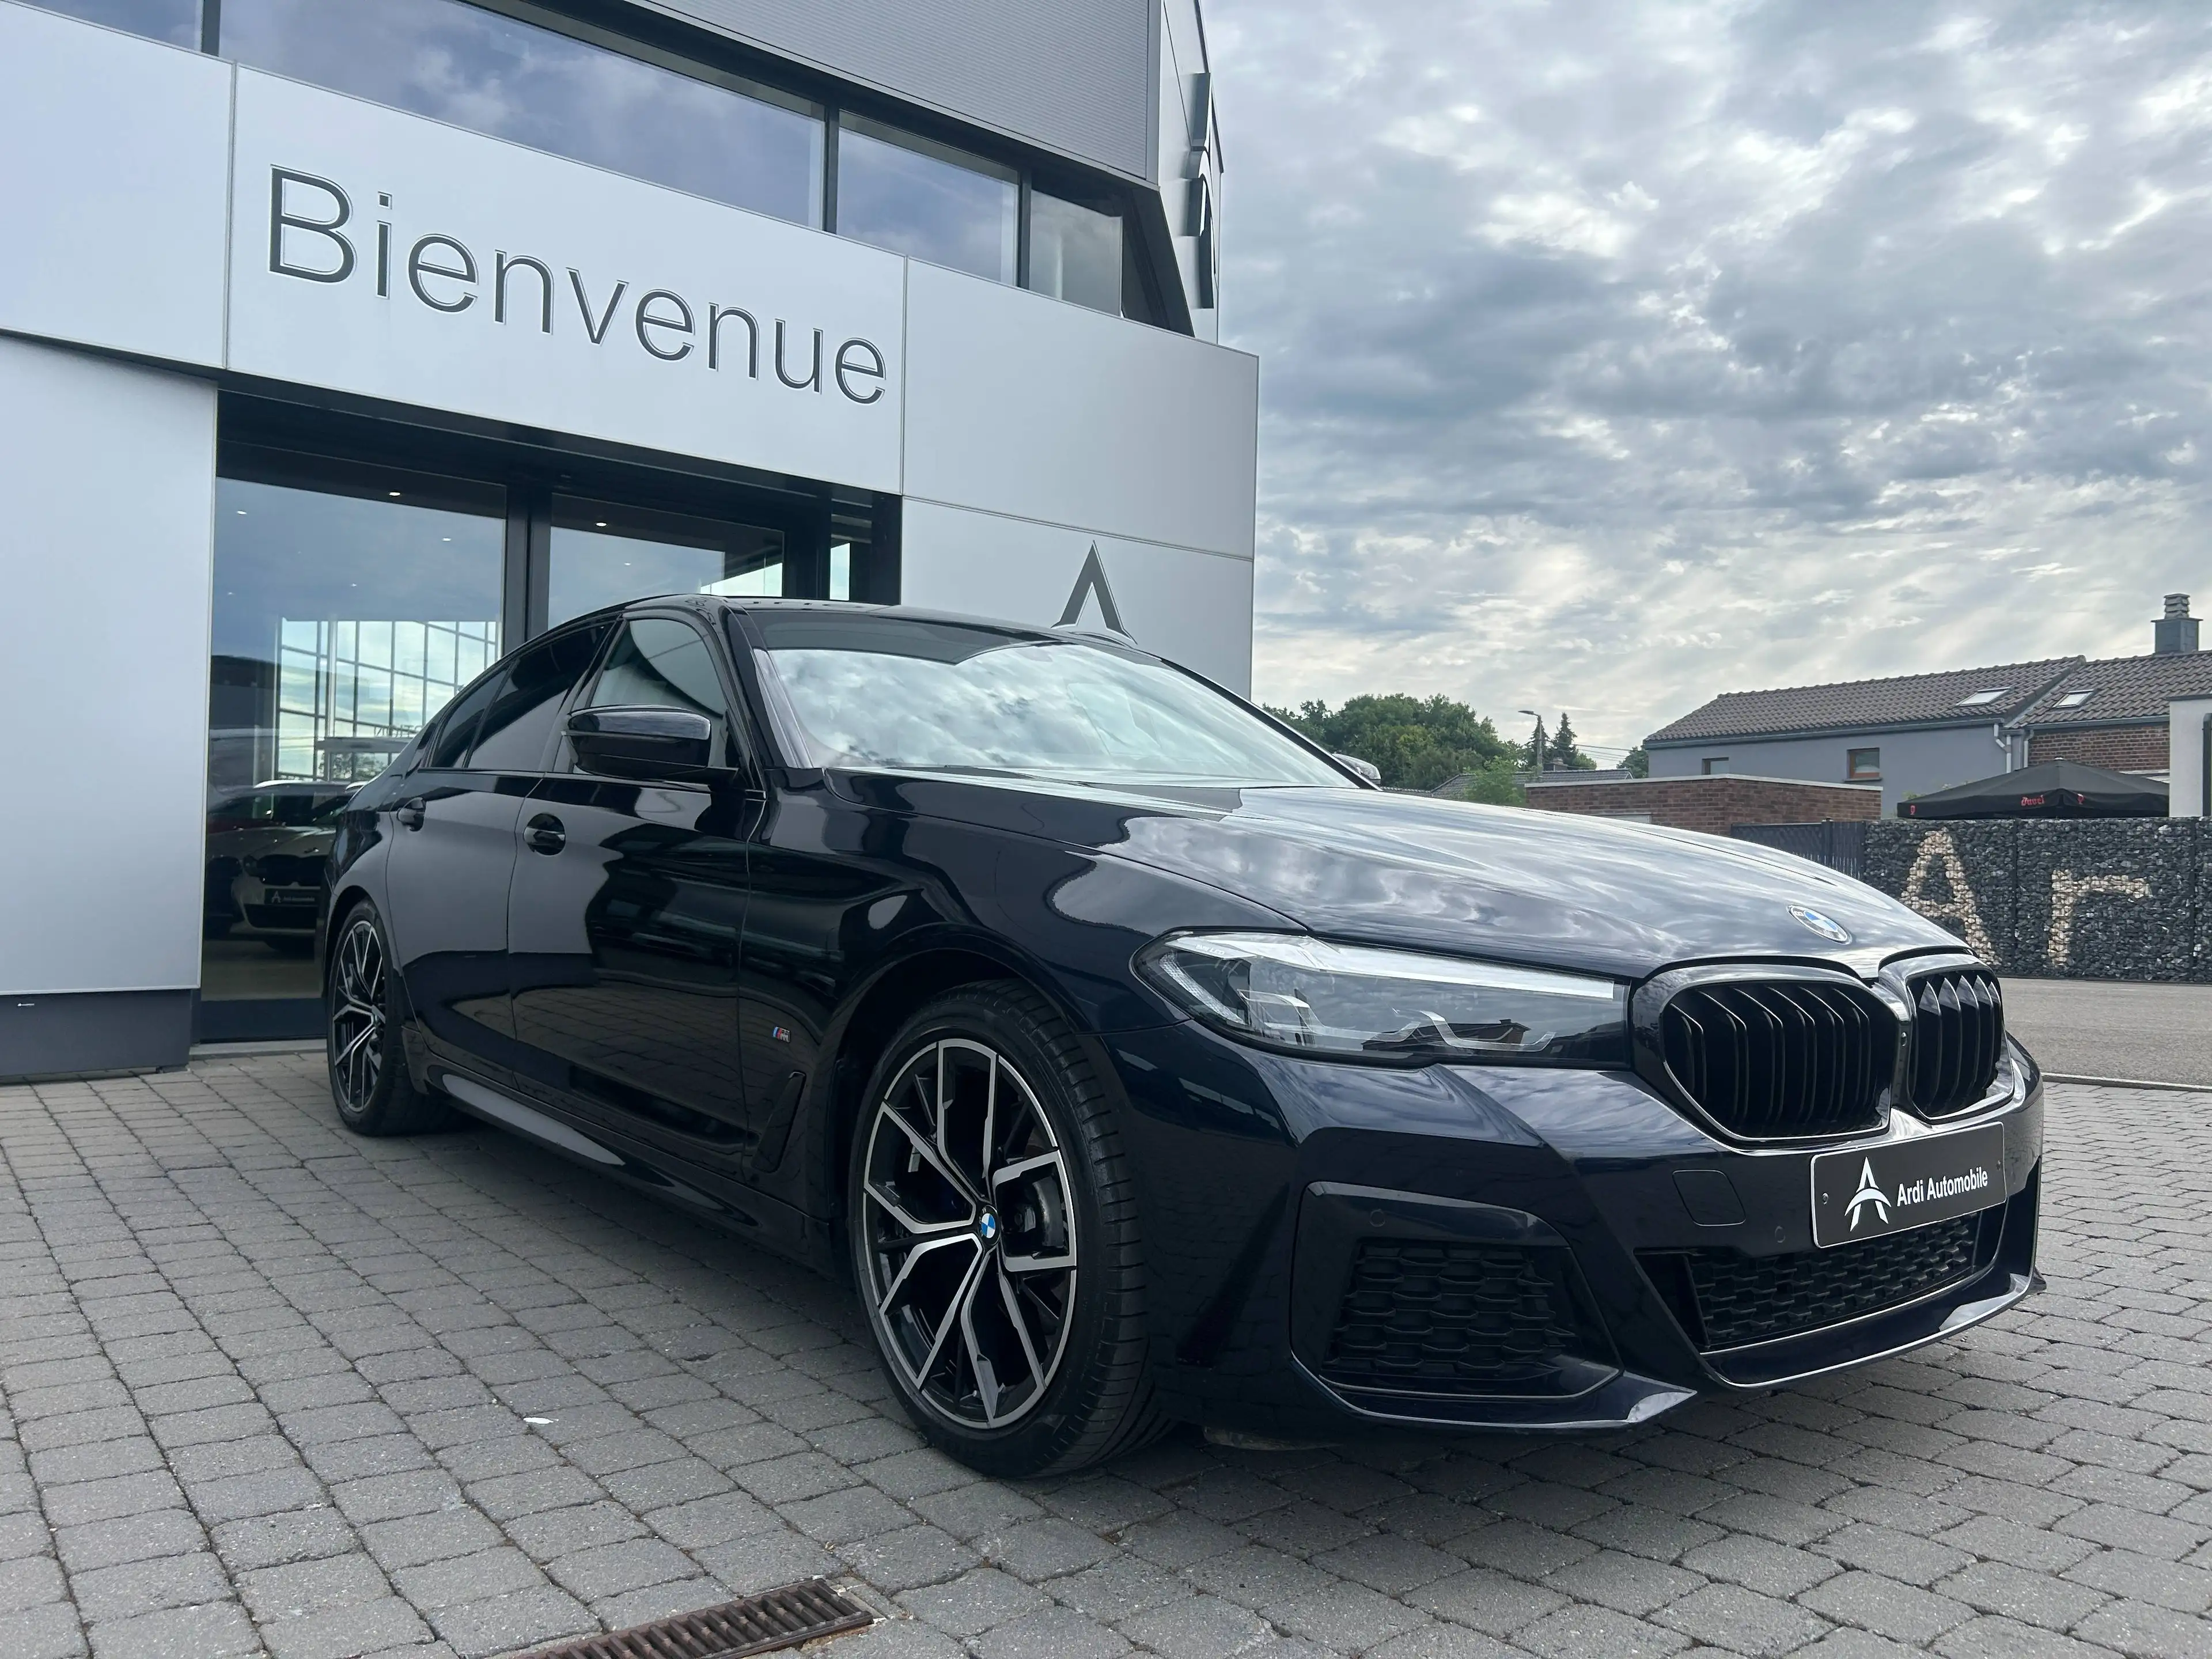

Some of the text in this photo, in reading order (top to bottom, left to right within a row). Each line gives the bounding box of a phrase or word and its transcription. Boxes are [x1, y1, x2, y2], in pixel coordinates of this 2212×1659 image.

[268, 164, 886, 405] Bienvenue
[2021, 795, 2044, 806] Duvel
[1897, 1166, 1988, 1207] Ardi Automobile
